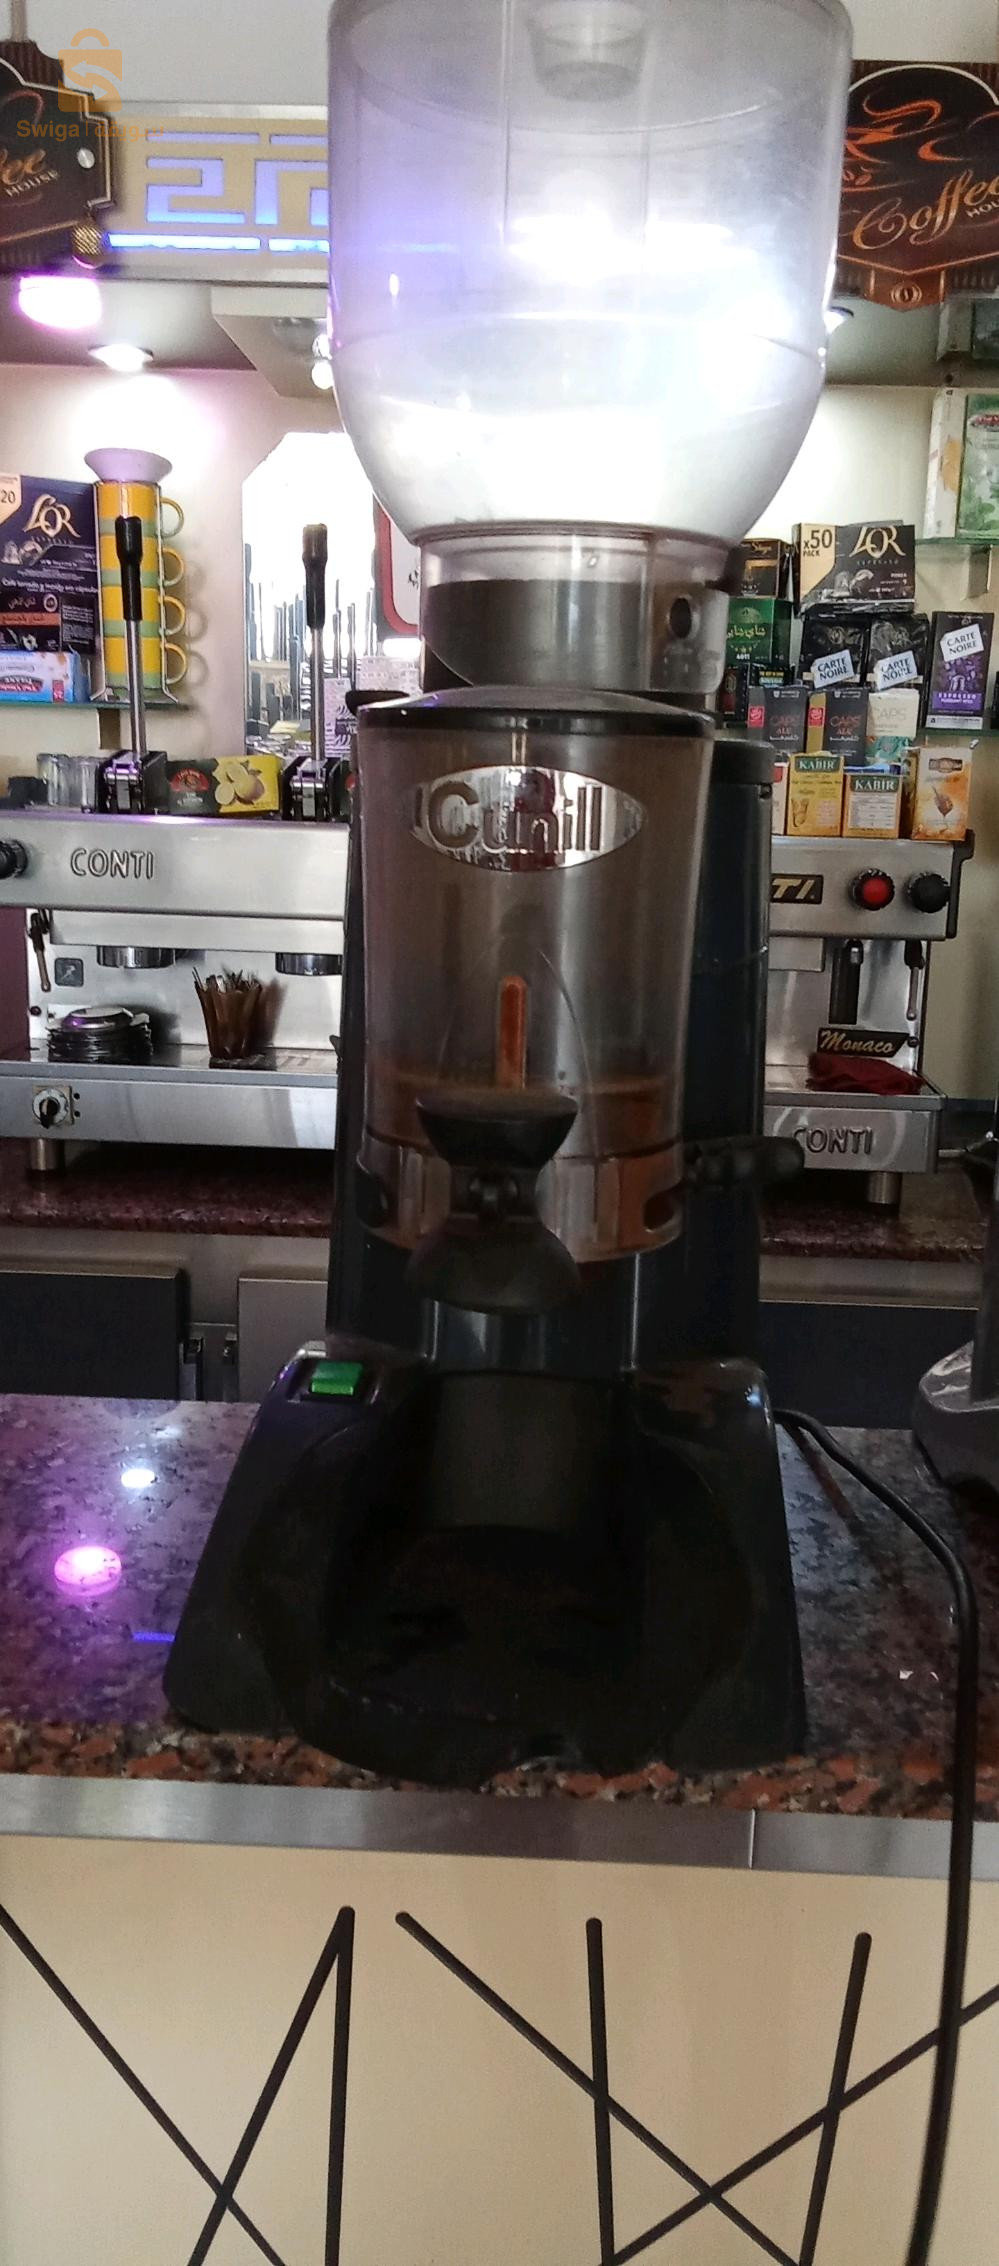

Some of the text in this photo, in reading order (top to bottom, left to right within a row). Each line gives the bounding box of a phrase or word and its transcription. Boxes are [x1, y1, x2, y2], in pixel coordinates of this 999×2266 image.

[802, 549, 821, 557] PACK
[947, 632, 976, 647] CARTE
[949, 640, 977, 655] NOIRE
[817, 658, 846, 672] CARTE
[819, 667, 848, 681] NOIRE
[799, 759, 835, 770] KABIR
[854, 778, 895, 791] KABIR
[428, 780, 603, 850] Cunill
[70, 847, 154, 880] CONTI
[820, 1030, 895, 1054] Monaco
